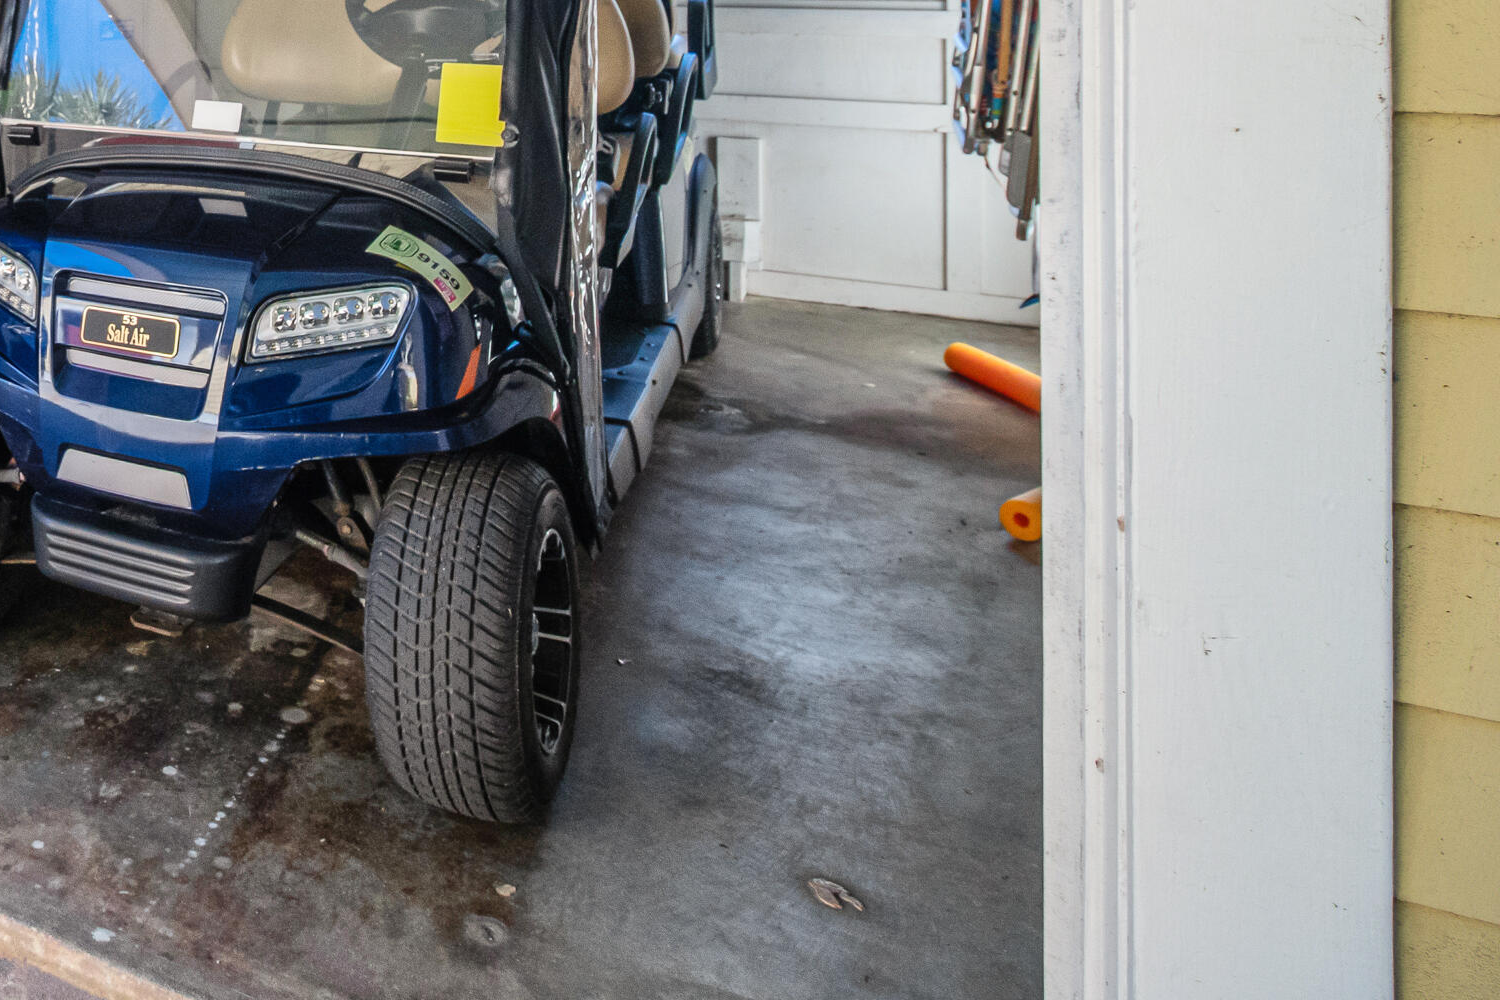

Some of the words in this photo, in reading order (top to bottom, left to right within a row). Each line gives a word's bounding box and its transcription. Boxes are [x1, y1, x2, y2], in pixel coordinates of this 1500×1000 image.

[417, 252, 460, 290] 9159
[122, 314, 138, 326] 53
[106, 323, 130, 344] Salt
[129, 327, 150, 347] Air
